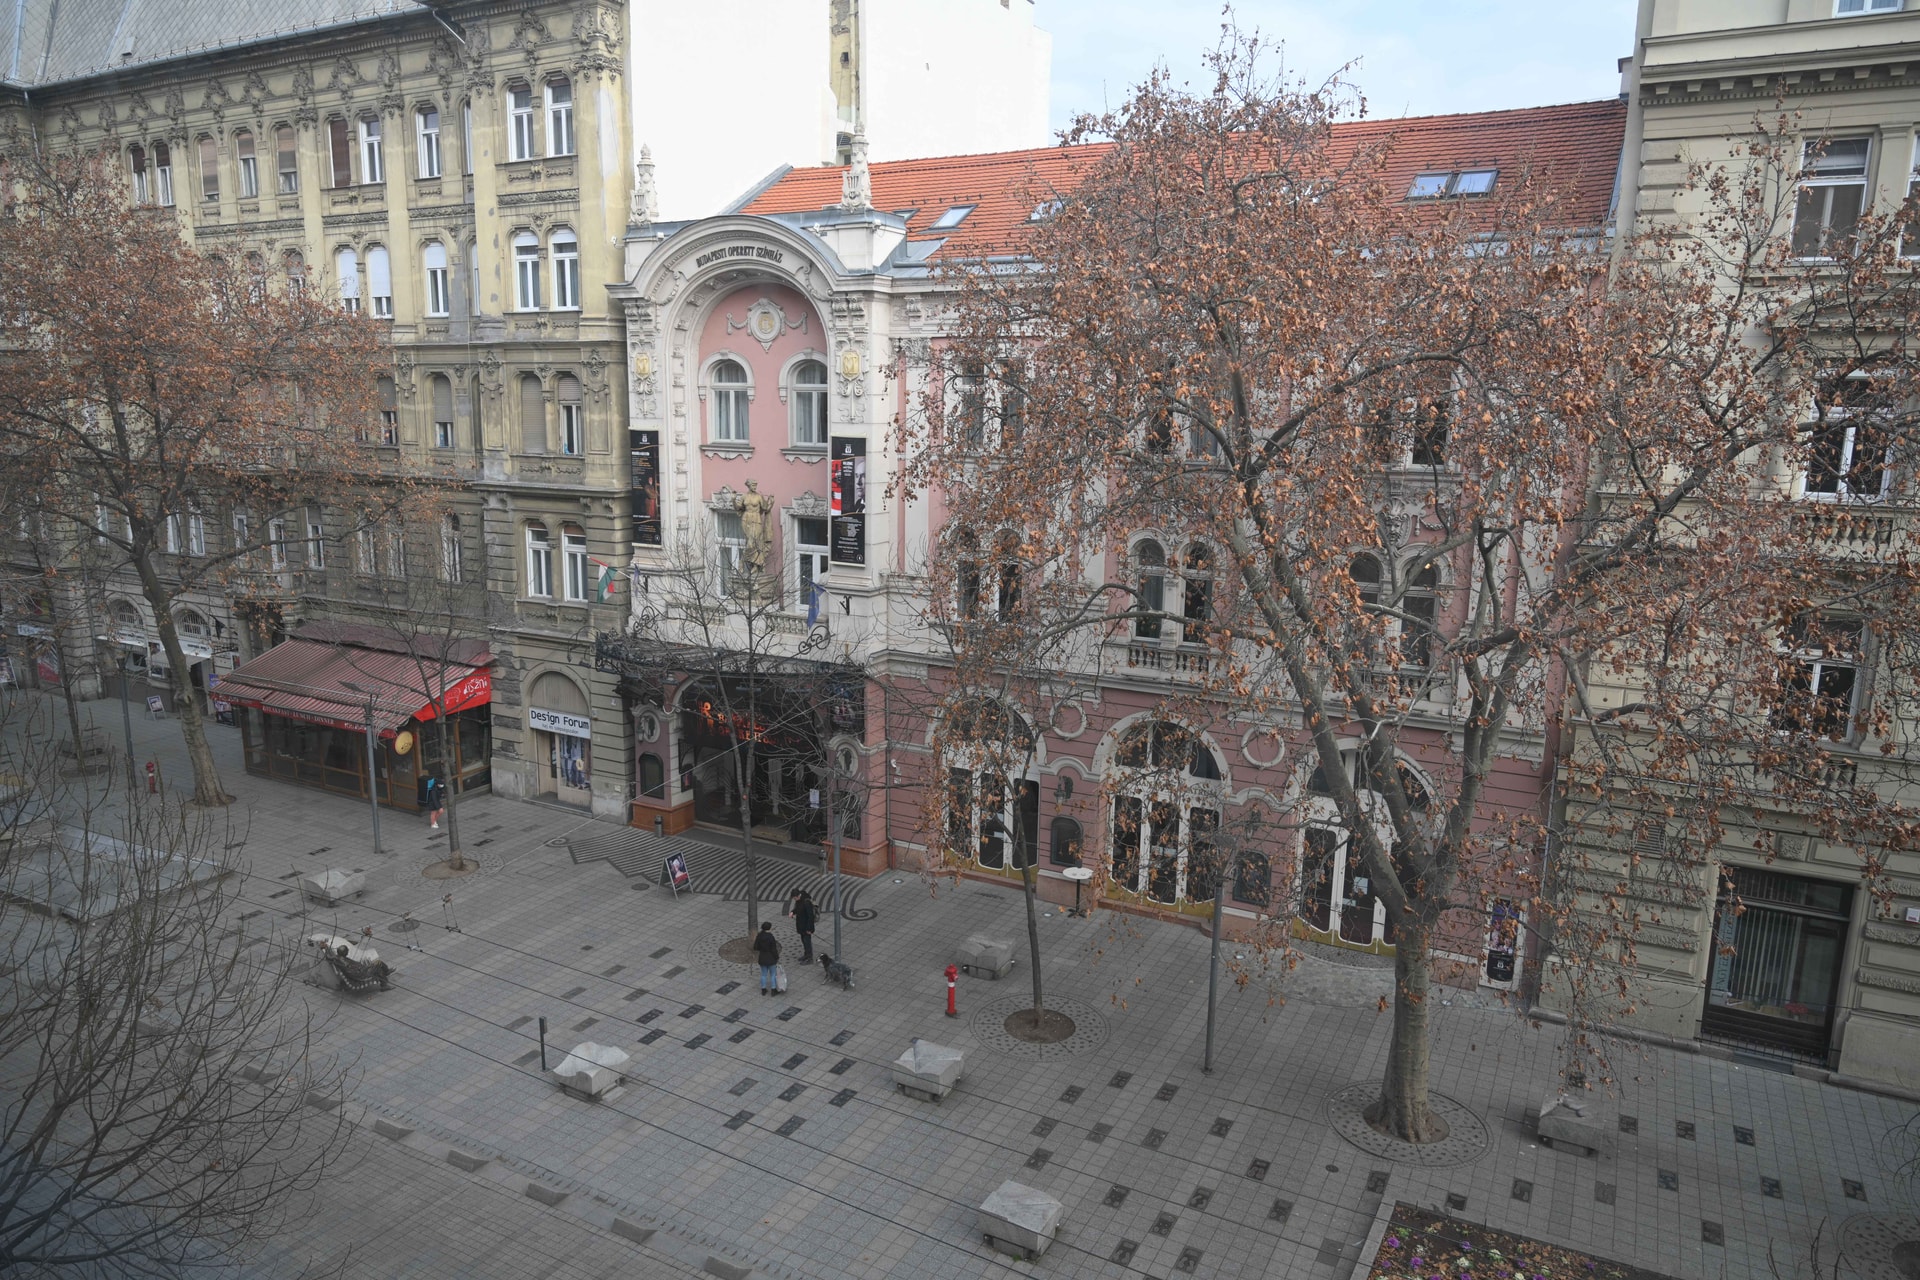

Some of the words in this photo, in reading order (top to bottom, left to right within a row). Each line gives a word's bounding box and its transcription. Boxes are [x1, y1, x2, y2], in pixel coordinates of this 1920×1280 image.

[696, 248, 727, 267] BUDAPESTI
[728, 246, 755, 256] OPERETT
[756, 246, 783, 263] SZÍNHÁZ
[531, 710, 560, 725] Design
[563, 716, 590, 730] Forum
